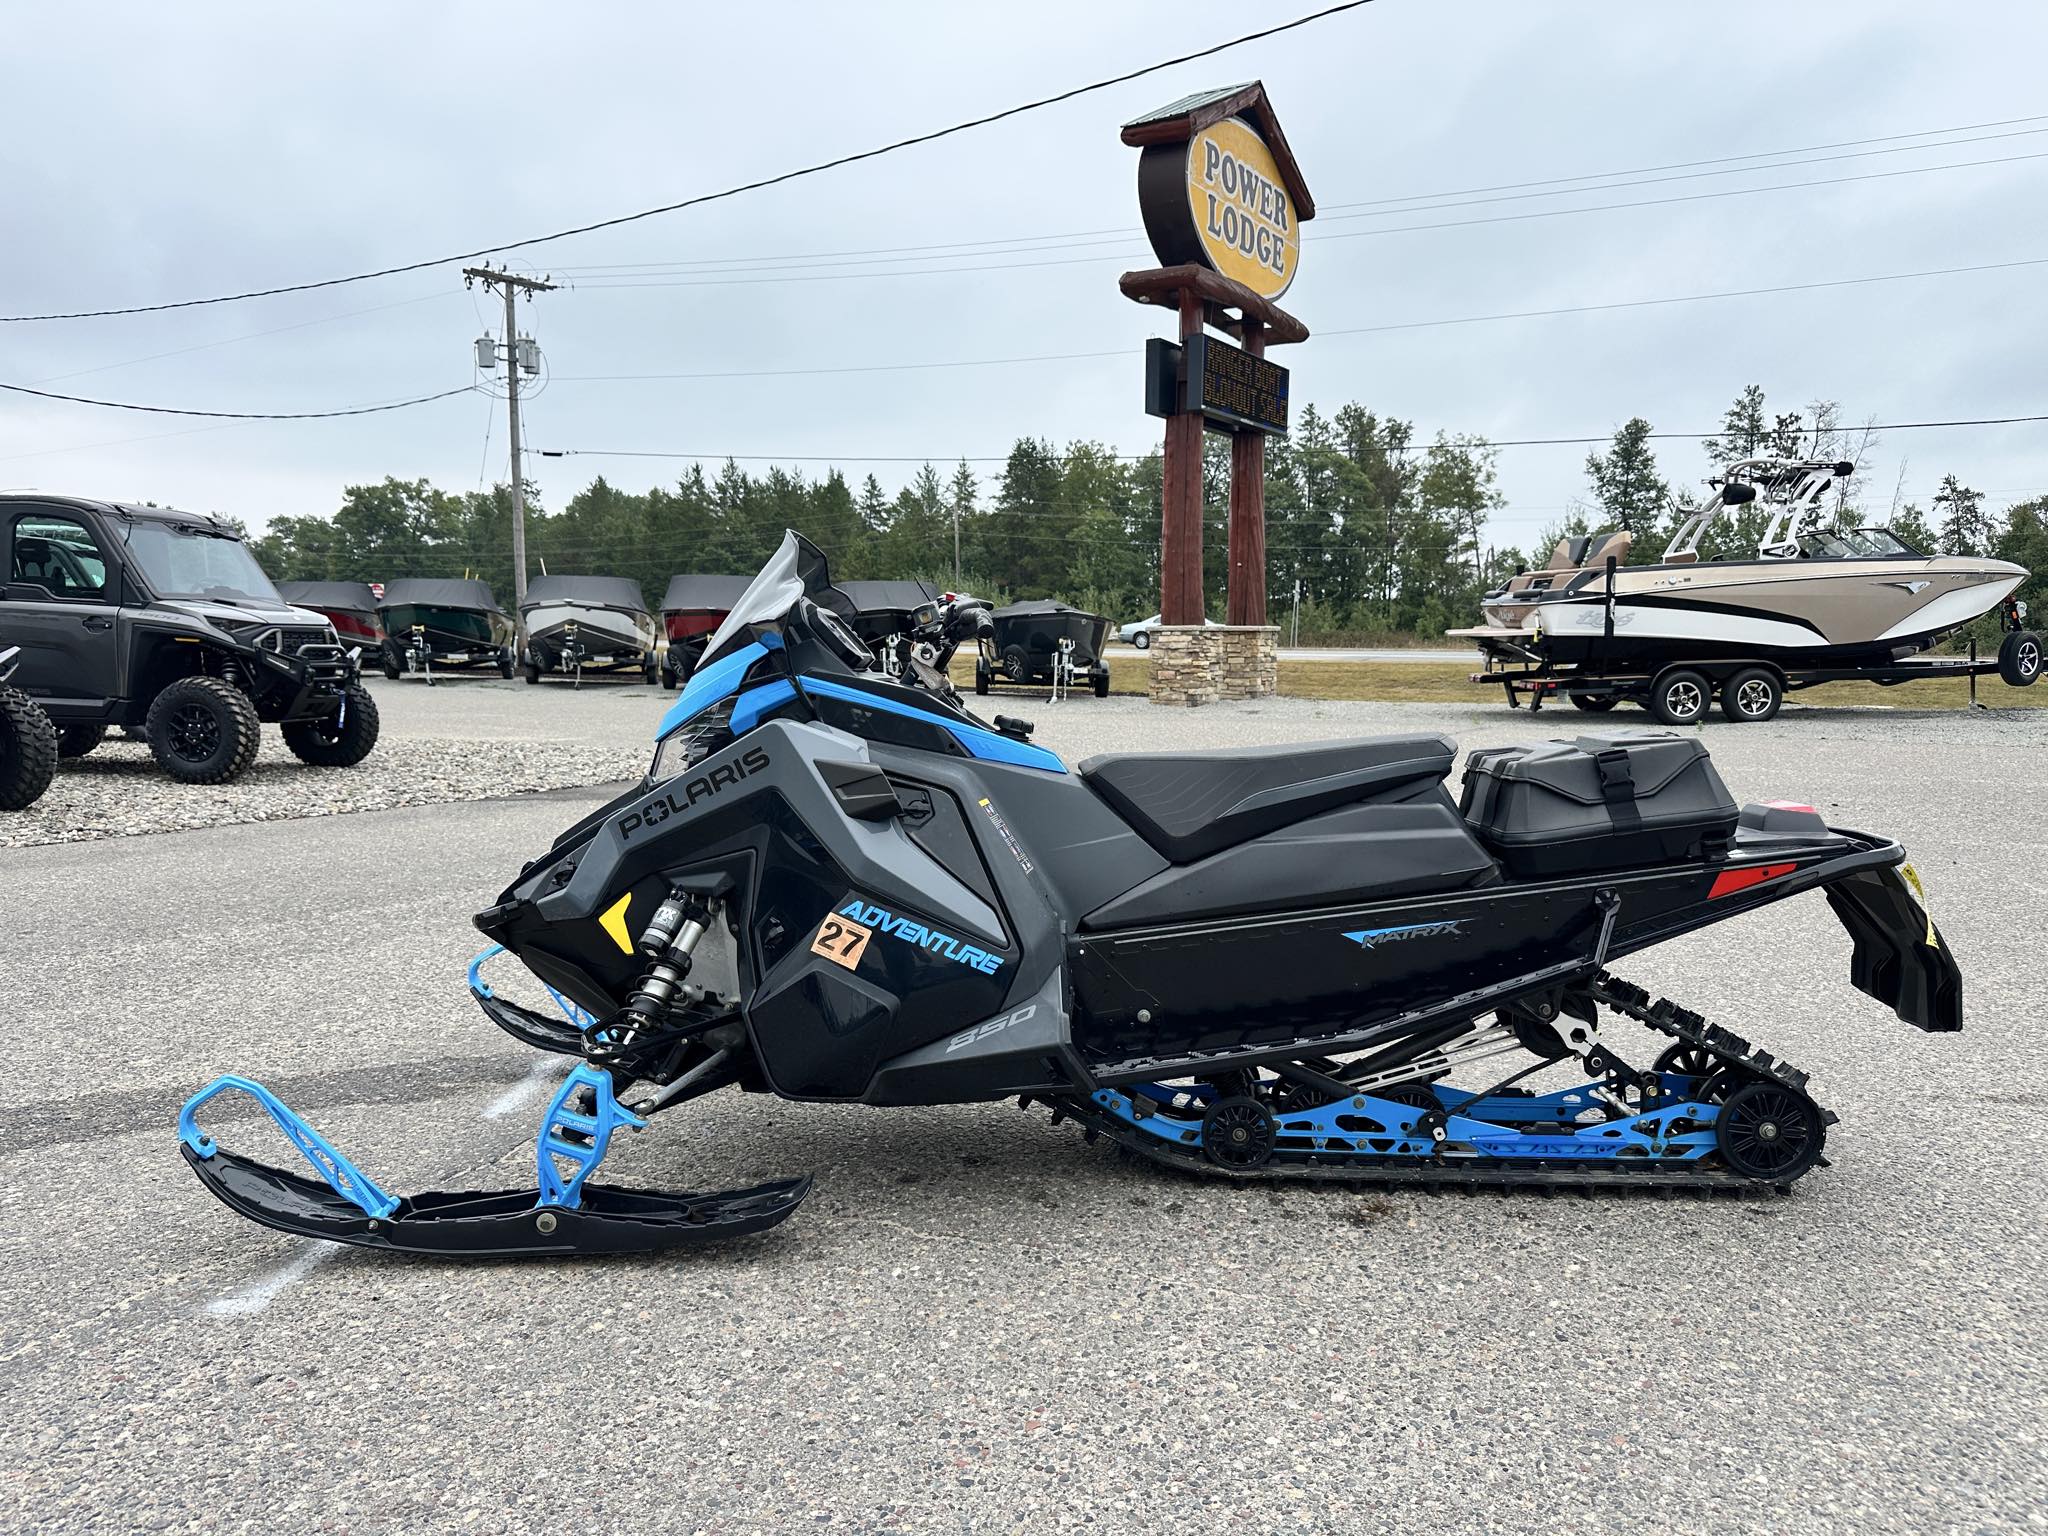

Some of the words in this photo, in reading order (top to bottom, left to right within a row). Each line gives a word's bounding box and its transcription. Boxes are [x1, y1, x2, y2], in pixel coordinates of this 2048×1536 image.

[1205, 140, 1288, 232] POWER
[1207, 193, 1285, 274] LODGE
[1207, 340, 1252, 386] RANGER
[1255, 361, 1281, 396] BOAT
[1204, 371, 1257, 416] BLOWOUT
[1260, 393, 1287, 426] SALE
[617, 746, 770, 841] POLARIS
[817, 921, 865, 957] 27
[839, 900, 1005, 976] ADVENTURE
[1361, 920, 1463, 949] MATRYX
[945, 1004, 1037, 1054] 850
[556, 1115, 595, 1131] POLARIS
